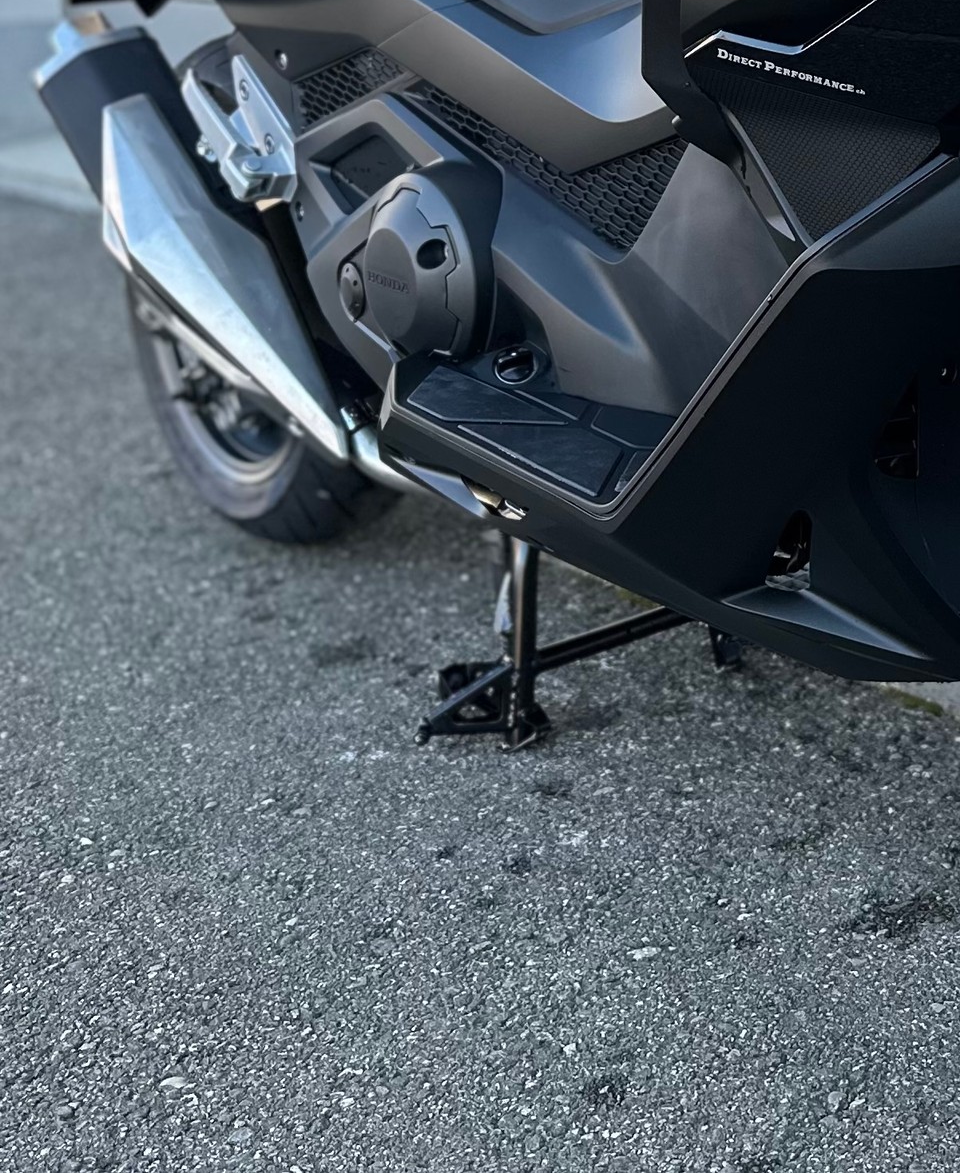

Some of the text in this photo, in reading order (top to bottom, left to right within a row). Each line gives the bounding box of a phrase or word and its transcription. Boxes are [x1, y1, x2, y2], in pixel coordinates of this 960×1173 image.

[716, 47, 763, 70] DIRECT
[763, 60, 855, 93] PERFORMANCE
[367, 271, 410, 294] HONDA
